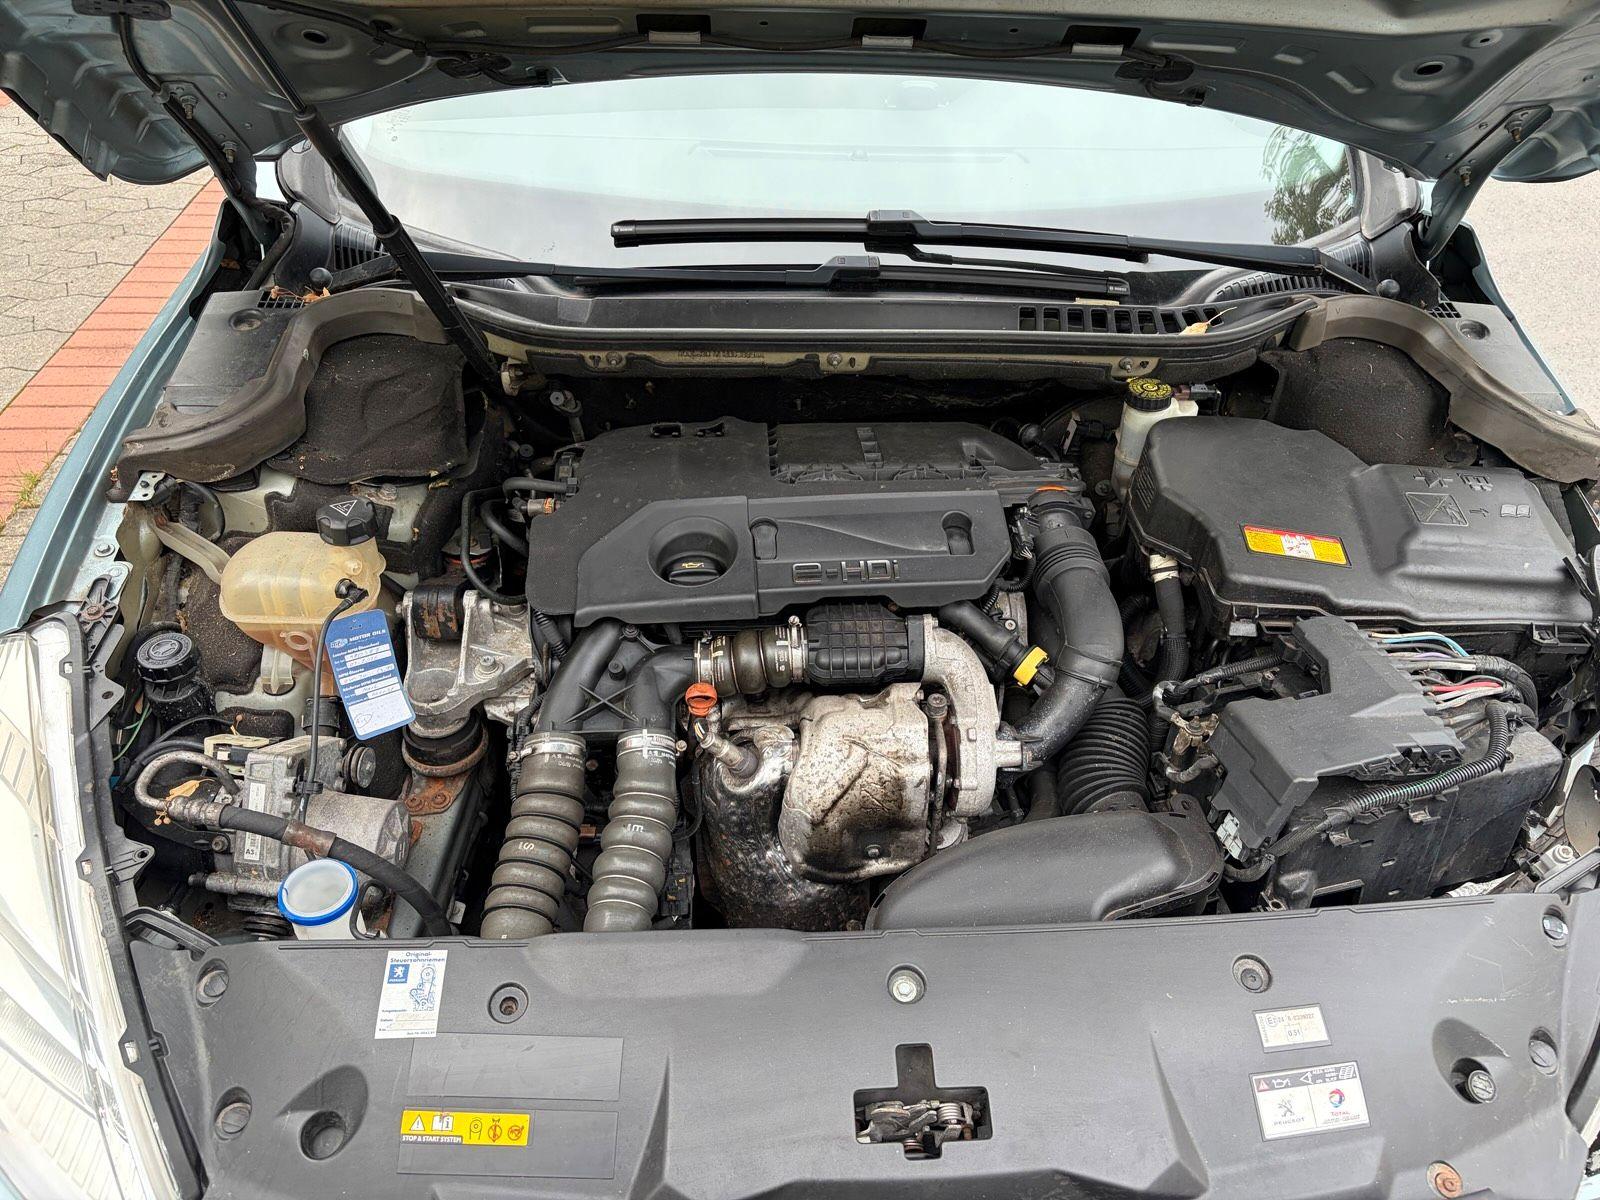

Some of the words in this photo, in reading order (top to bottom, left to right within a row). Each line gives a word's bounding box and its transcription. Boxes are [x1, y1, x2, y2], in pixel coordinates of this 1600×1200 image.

[792, 559, 900, 584] e-HDi
[349, 633, 371, 642] MOTOR
[1273, 1116, 1305, 1126] PEUGEOT
[402, 1134, 418, 1142] STOP
[422, 1135, 440, 1143] START
[440, 1136, 462, 1144] SYSTEM
